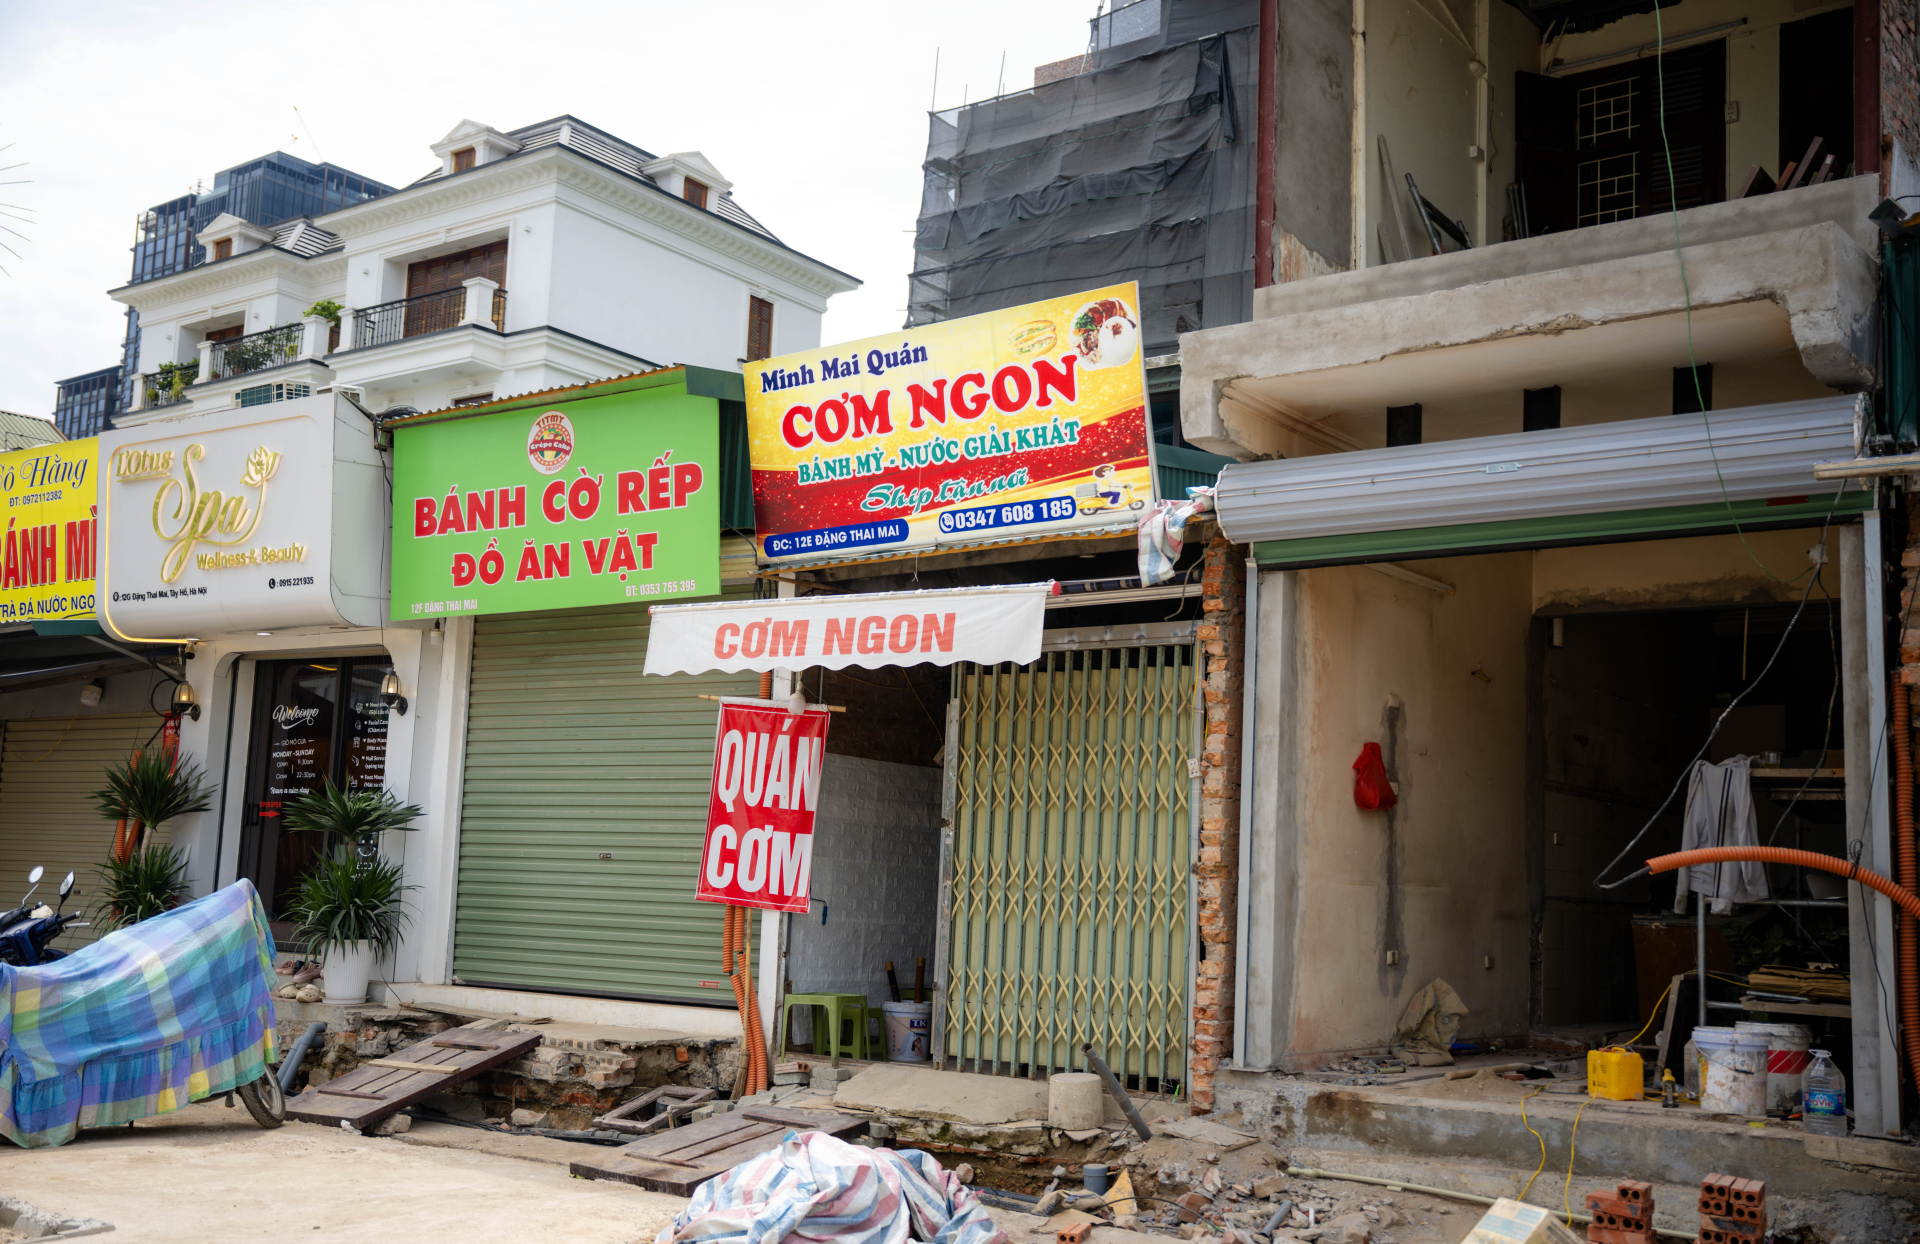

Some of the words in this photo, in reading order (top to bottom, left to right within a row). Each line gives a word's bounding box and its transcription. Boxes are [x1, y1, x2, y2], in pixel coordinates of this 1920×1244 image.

[760, 364, 815, 392] Minh
[820, 354, 860, 382] Mai
[866, 342, 928, 376] Quán
[781, 388, 894, 449] CƠM
[906, 354, 1078, 429] NGON
[536, 414, 565, 428] TITMY
[553, 442, 570, 451] Cake
[798, 455, 851, 484] BÁNH
[856, 446, 884, 474] MỲ
[900, 436, 959, 468] NƯỚC
[964, 426, 1013, 458] GIẢI
[1016, 418, 1080, 450] KHÁT
[20, 454, 88, 489] Hằng
[10, 497, 21, 507] ĐT:
[23, 490, 62, 505] 0972112382
[414, 485, 527, 538] BÁNH
[542, 467, 603, 524] CỜ
[617, 449, 703, 516] RẾP
[862, 484, 932, 513] Ship
[936, 478, 986, 502] tận
[987, 467, 1029, 494] nơi
[152, 444, 251, 583] Spa
[955, 510, 996, 529] 0347
[1002, 504, 1034, 524] 608
[1040, 500, 1073, 518] 185
[0, 516, 57, 590] ÁNH
[773, 540, 792, 551] ĐC:
[794, 536, 812, 548] 12E
[814, 530, 847, 548] ĐẶNG
[849, 528, 875, 542] THAI
[878, 524, 900, 538] MAI
[196, 552, 247, 570] Wellness
[249, 549, 261, 564] &
[262, 542, 307, 563] Beauty
[451, 537, 505, 588] ĐỒ
[515, 539, 570, 582] ĂN
[582, 528, 658, 582] VẶT
[146, 591, 157, 600] Thai
[170, 590, 178, 598] Tây
[198, 586, 207, 596] Nội
[280, 579, 292, 588] 0915
[626, 586, 637, 596] ĐT:
[640, 584, 660, 596] 0353
[662, 582, 678, 593] 755
[680, 580, 696, 591] 395
[20, 597, 34, 616] ĐÁ
[38, 594, 68, 614] NƯỚC
[71, 594, 96, 612] NGỌ
[411, 604, 423, 614] 12F
[424, 602, 444, 615] ĐẶNG
[446, 600, 462, 612] THAI
[464, 599, 478, 610] MAI
[714, 618, 809, 660] CƠM
[822, 613, 956, 656] NGON
[272, 750, 292, 758] MONDAY
[717, 718, 822, 812] QUÁN
[706, 824, 812, 898] CƠM
